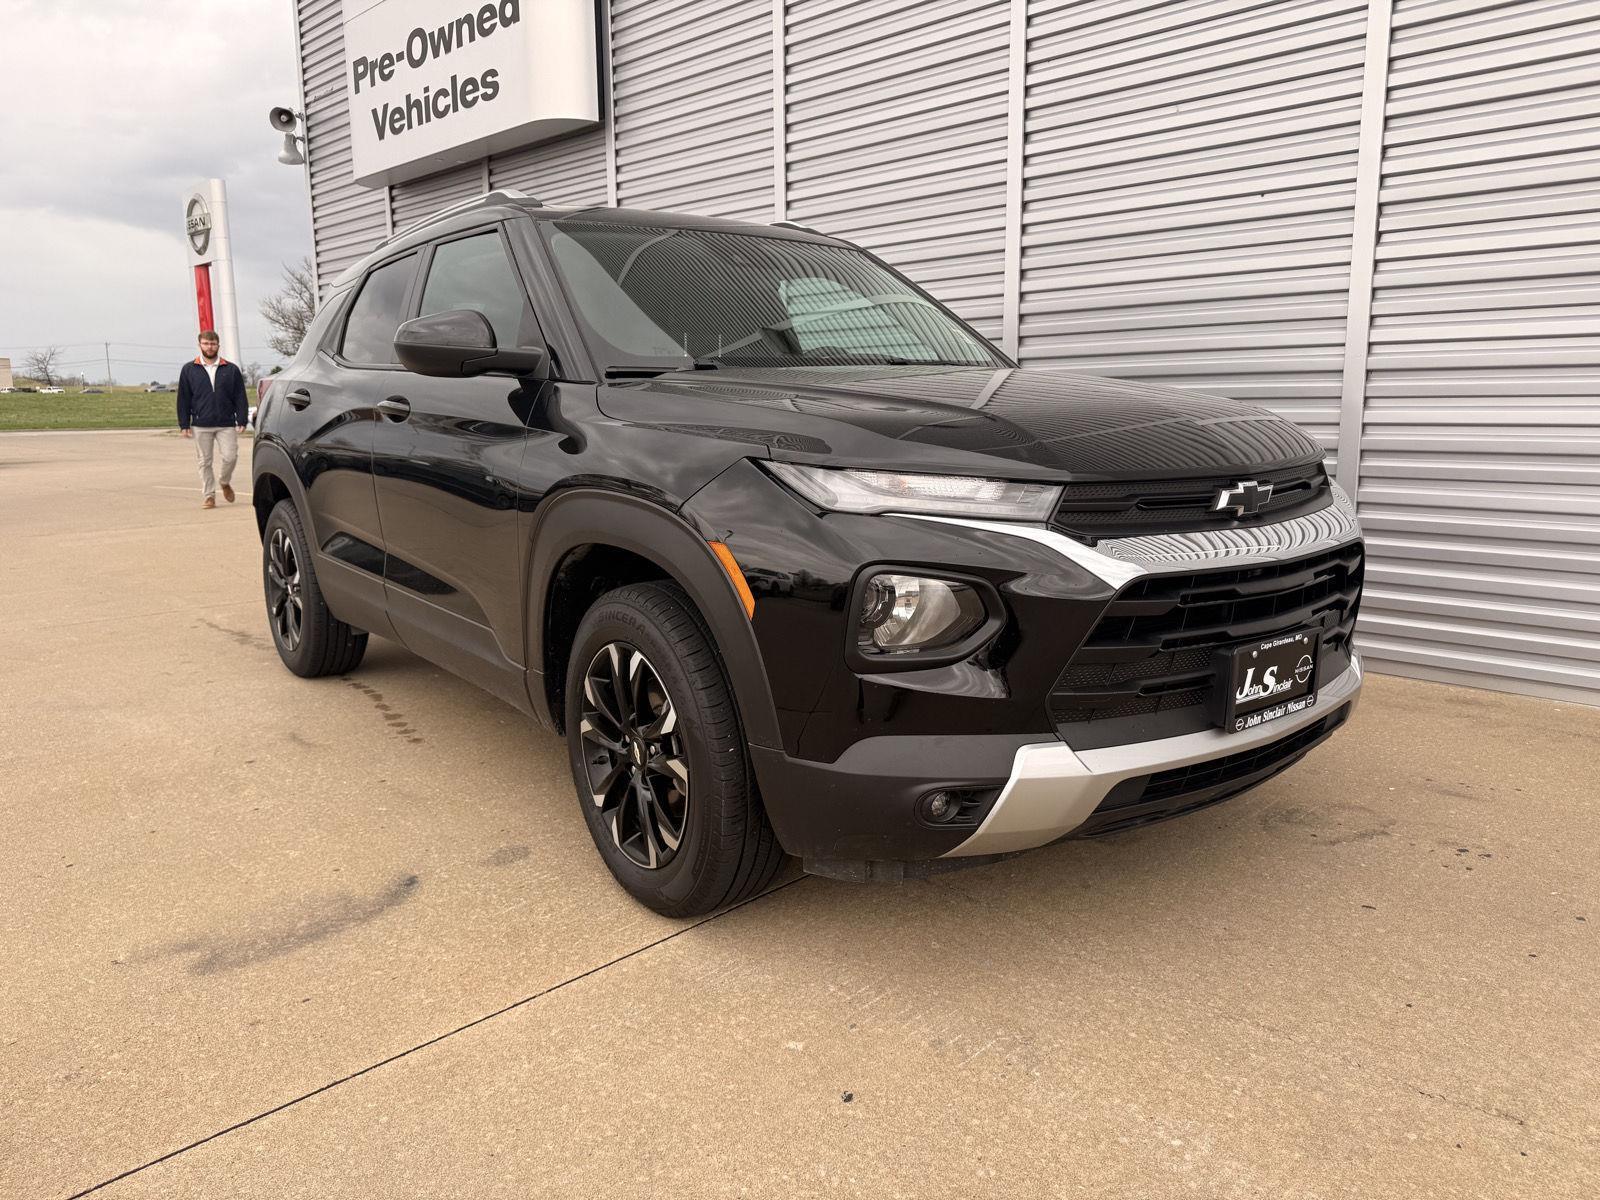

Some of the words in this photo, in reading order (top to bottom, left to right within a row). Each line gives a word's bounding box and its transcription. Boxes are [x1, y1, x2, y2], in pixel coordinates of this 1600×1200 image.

[352, 0, 520, 95] Pre-Owned
[371, 68, 500, 141] Vehicles
[1295, 633, 1303, 641] MO
[1235, 667, 1262, 700] John
[1260, 665, 1294, 697] Sinclair
[1294, 664, 1314, 674] NISSAN
[1245, 715, 1262, 728] John
[1262, 706, 1286, 722] Sinclair
[1286, 700, 1306, 715] Nissan
